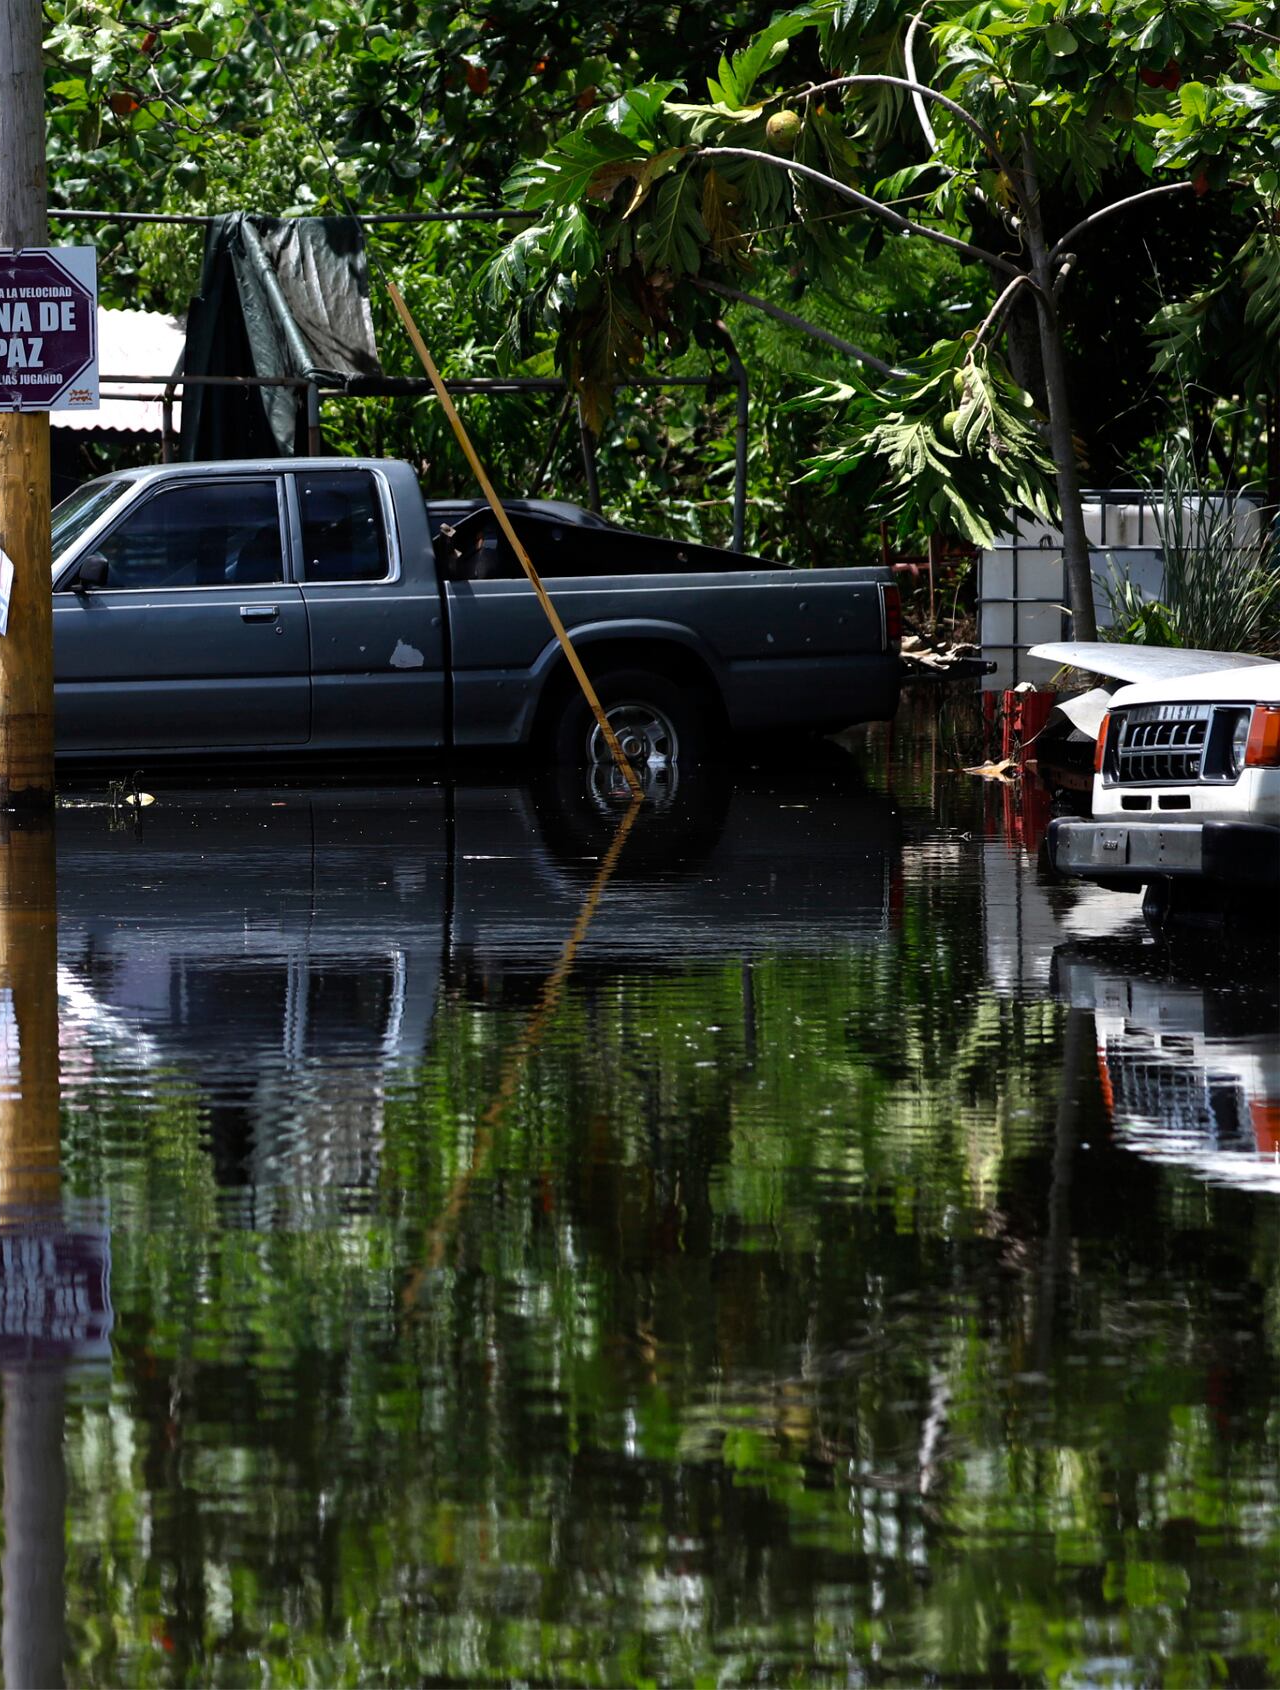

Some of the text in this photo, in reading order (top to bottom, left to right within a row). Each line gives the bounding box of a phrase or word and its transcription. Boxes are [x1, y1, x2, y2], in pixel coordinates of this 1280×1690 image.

[6, 288, 18, 298] LA
[19, 287, 72, 298] VELOCIDAD
[39, 301, 76, 332] DE
[19, 373, 63, 385] JUGANDO
